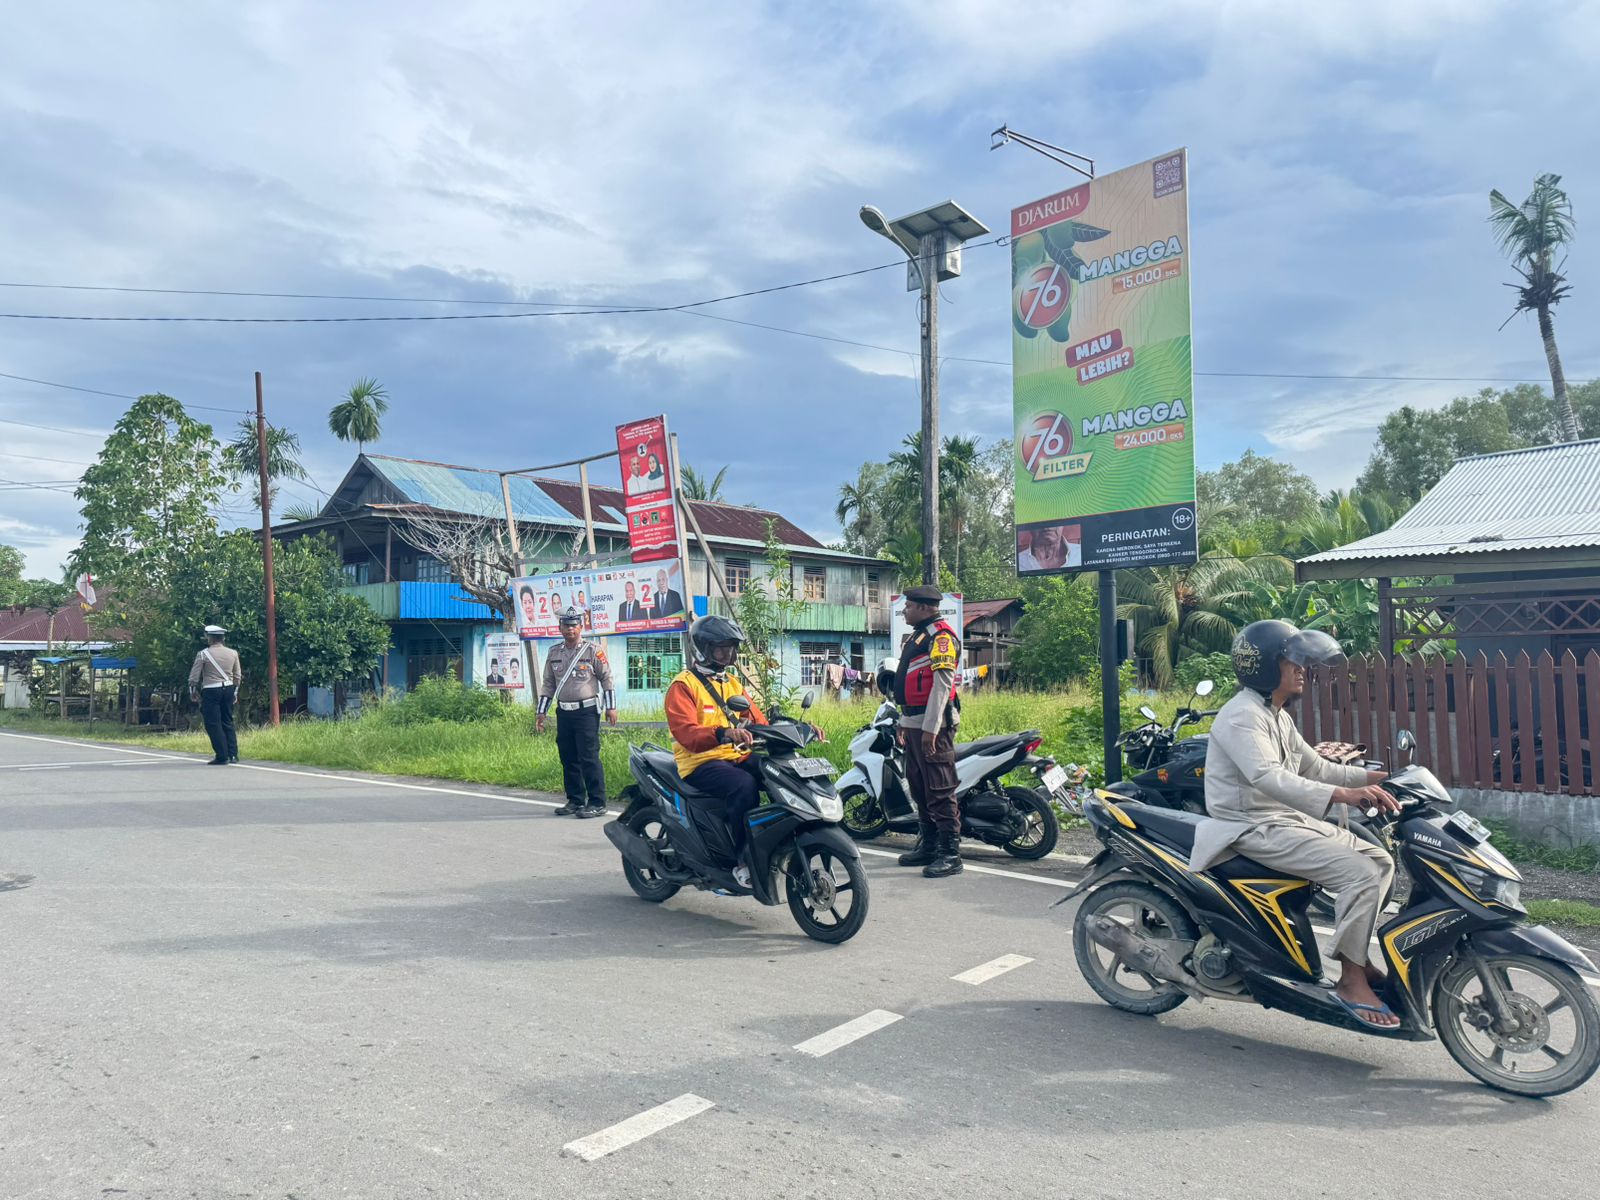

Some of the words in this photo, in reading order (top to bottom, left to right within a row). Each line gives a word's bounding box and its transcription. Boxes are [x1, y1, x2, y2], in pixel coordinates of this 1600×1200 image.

[1018, 192, 1080, 227] DJARUM
[1080, 236, 1183, 283] MANGGA
[1121, 267, 1162, 290] 15.000
[1022, 264, 1062, 326] 76
[1075, 334, 1112, 361] MAU
[1080, 351, 1130, 382] LEBIH?
[1082, 399, 1187, 437] MANGGA
[1024, 413, 1064, 471] 76
[1123, 428, 1166, 448] 24.000
[1043, 458, 1085, 475] FILTER
[1175, 514, 1191, 524] 18+
[1101, 527, 1171, 543] PERINGATAN:
[643, 584, 652, 602] 2
[539, 597, 547, 613] 2
[592, 604, 606, 612] BARU
[1414, 832, 1442, 847] YAMAHA
